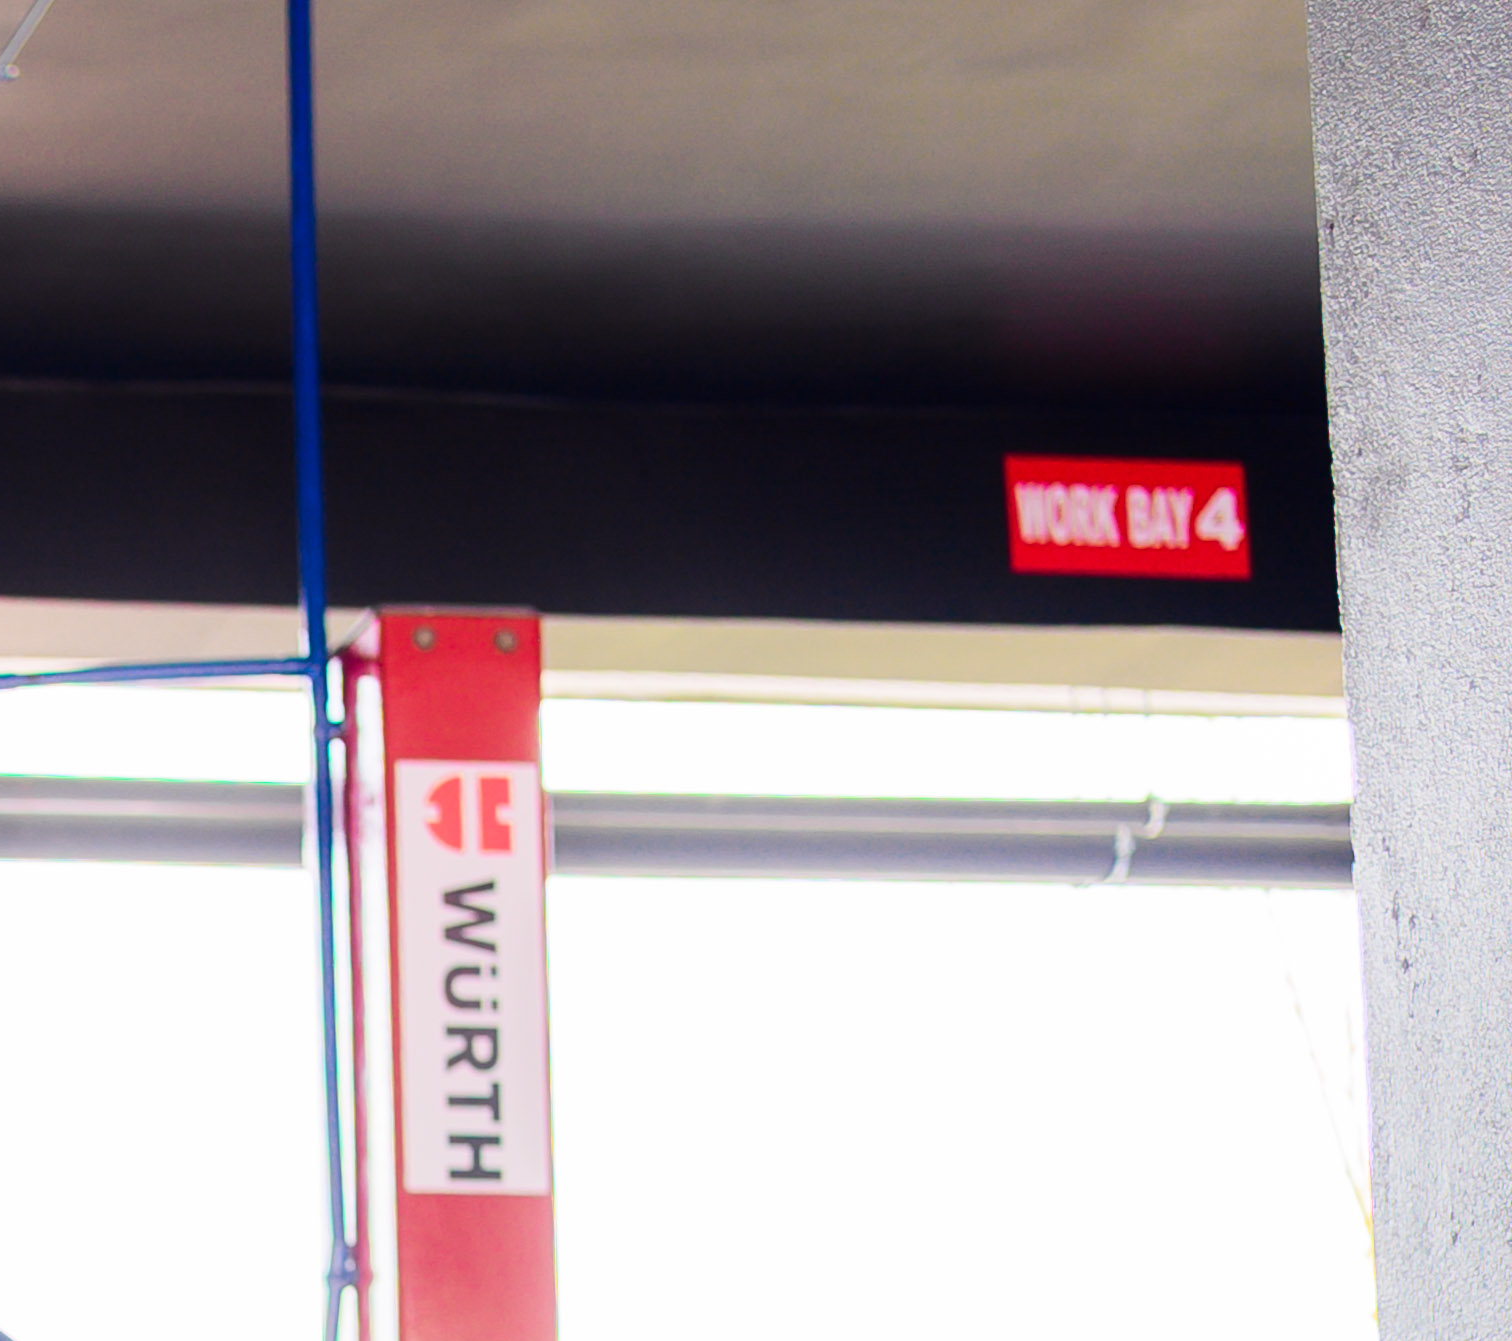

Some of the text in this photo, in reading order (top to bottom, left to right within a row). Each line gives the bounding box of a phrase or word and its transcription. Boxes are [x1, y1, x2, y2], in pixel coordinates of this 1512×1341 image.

[1014, 481, 1246, 552] WORK BAY 4
[441, 880, 502, 1183] WÜRTH
